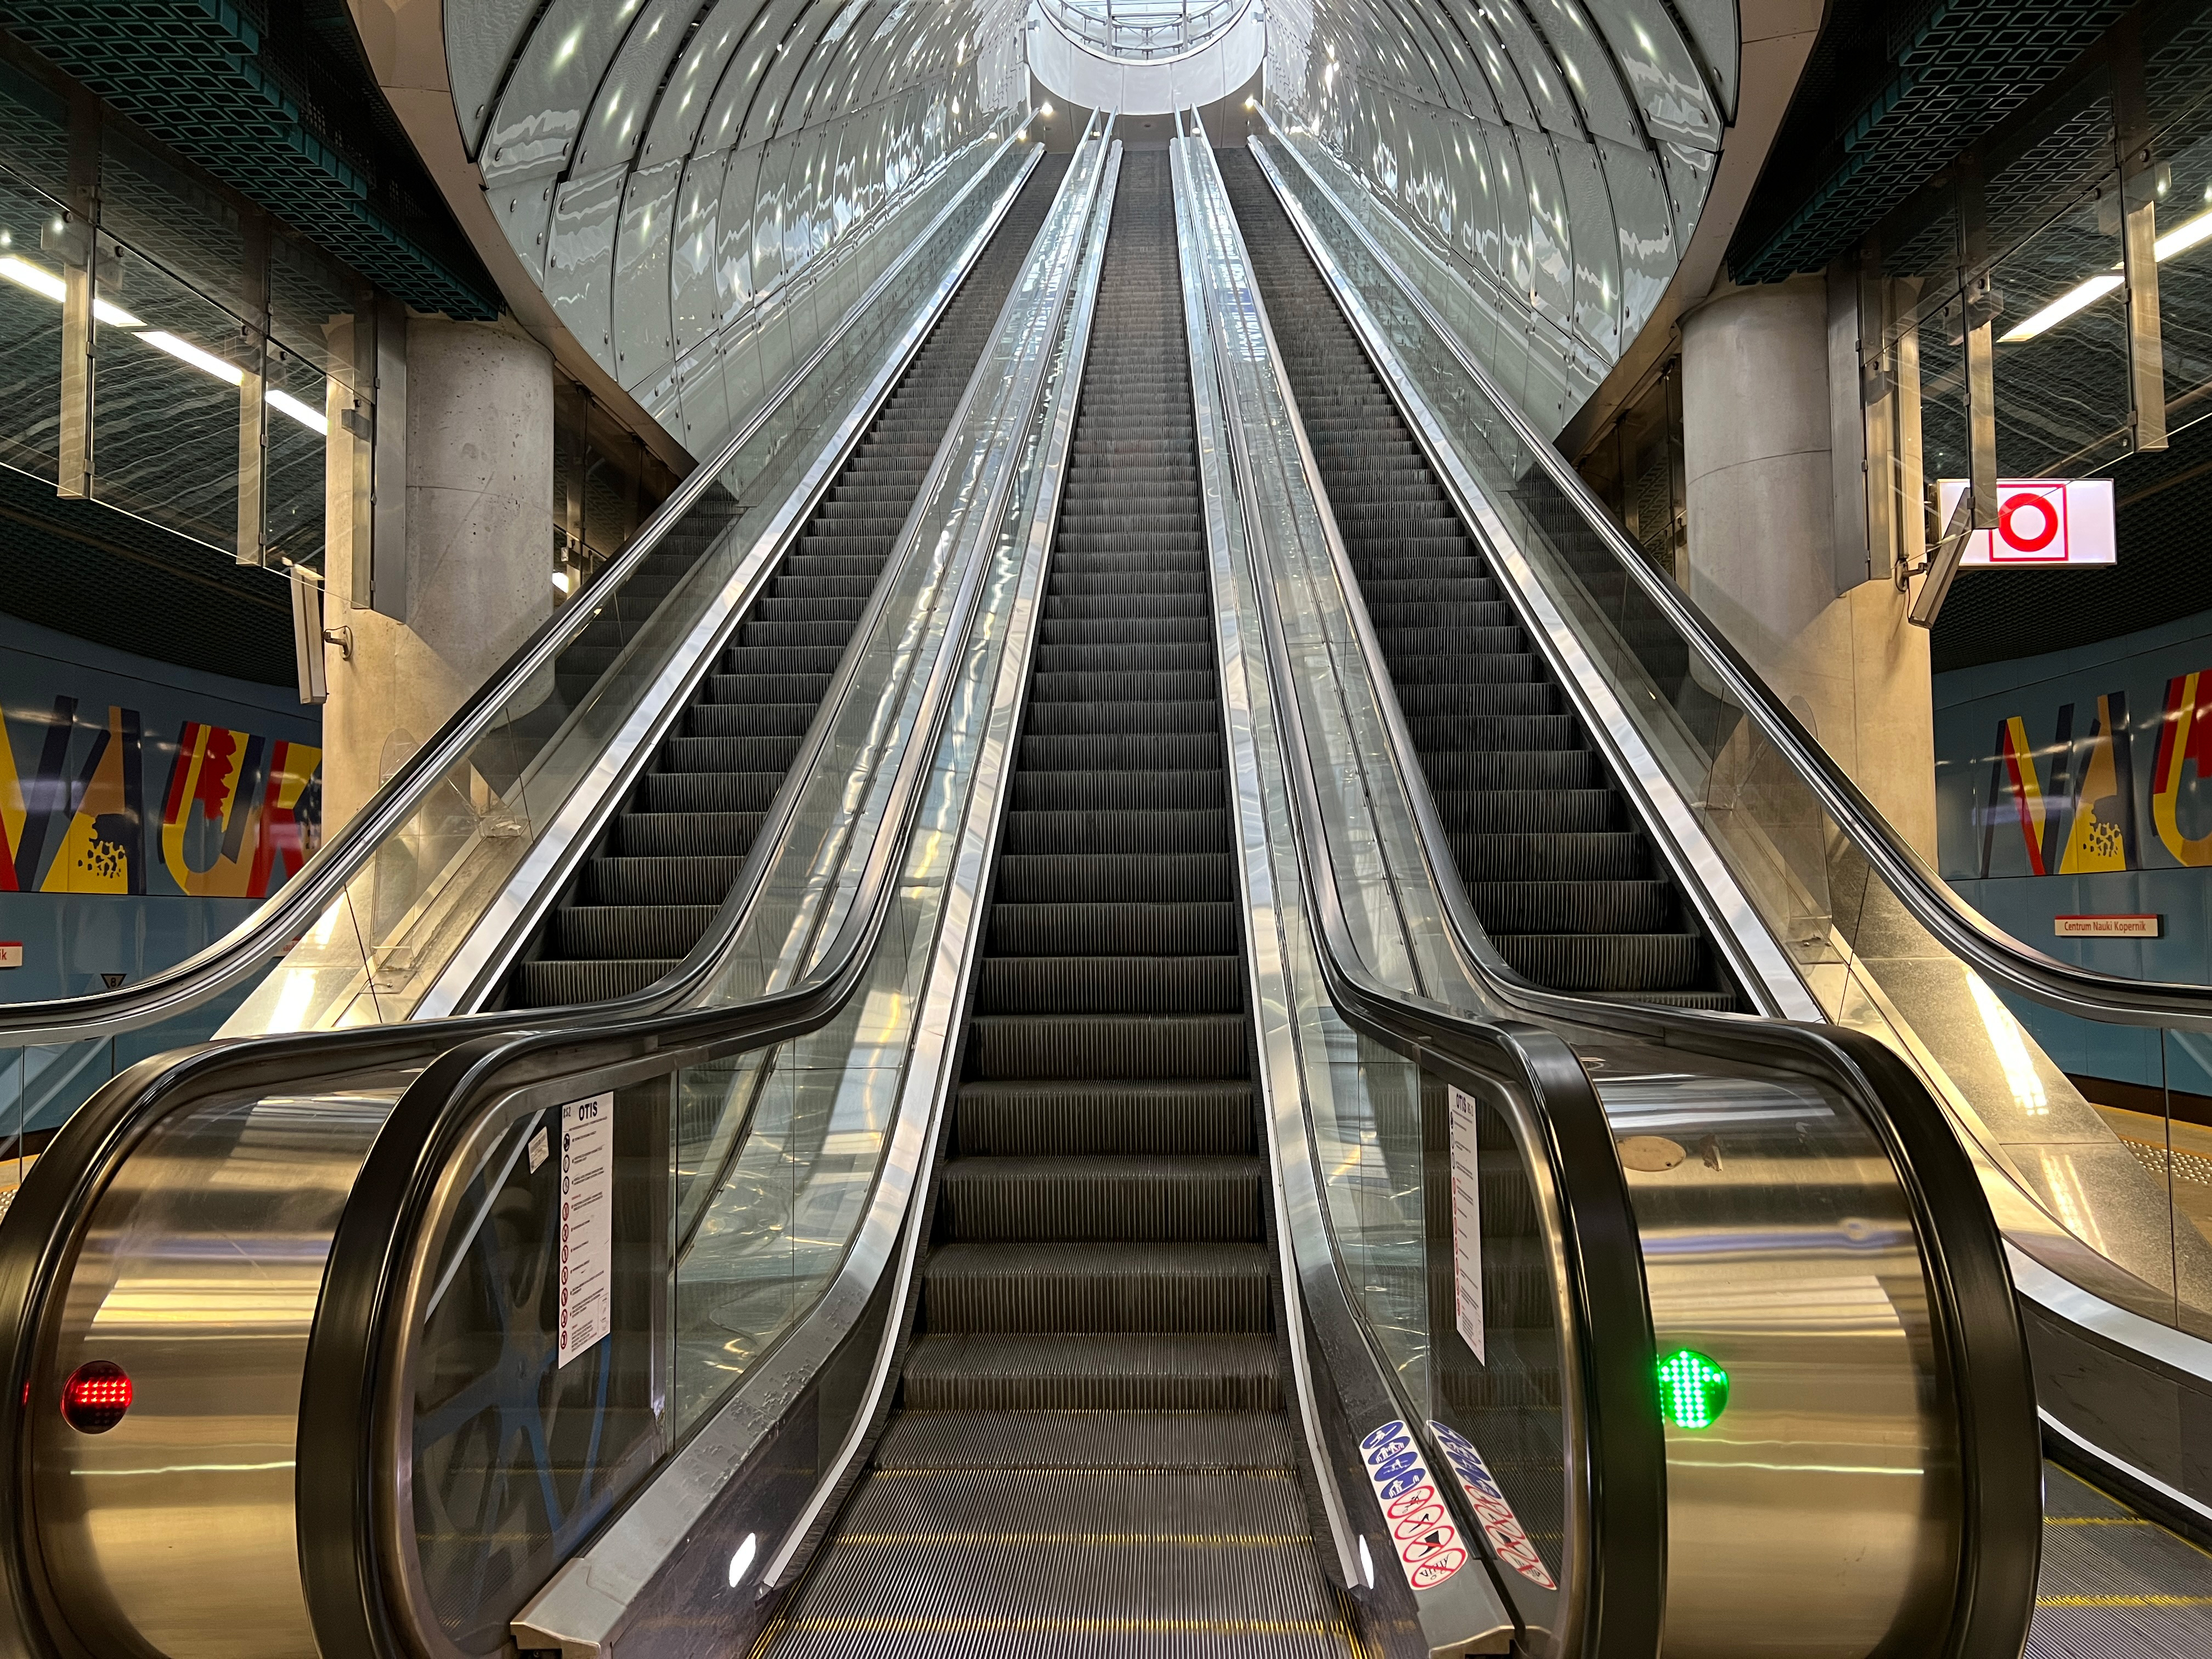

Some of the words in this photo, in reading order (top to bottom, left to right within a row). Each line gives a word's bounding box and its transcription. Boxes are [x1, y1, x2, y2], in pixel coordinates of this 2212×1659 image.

[2064, 921, 2091, 931] Centrum
[2093, 921, 2112, 931] Nauki
[2114, 920, 2146, 933] Kopernik
[111, 977, 116, 988] 8
[579, 1101, 597, 1121] OTIS
[1456, 1093, 1466, 1113] OTIS
